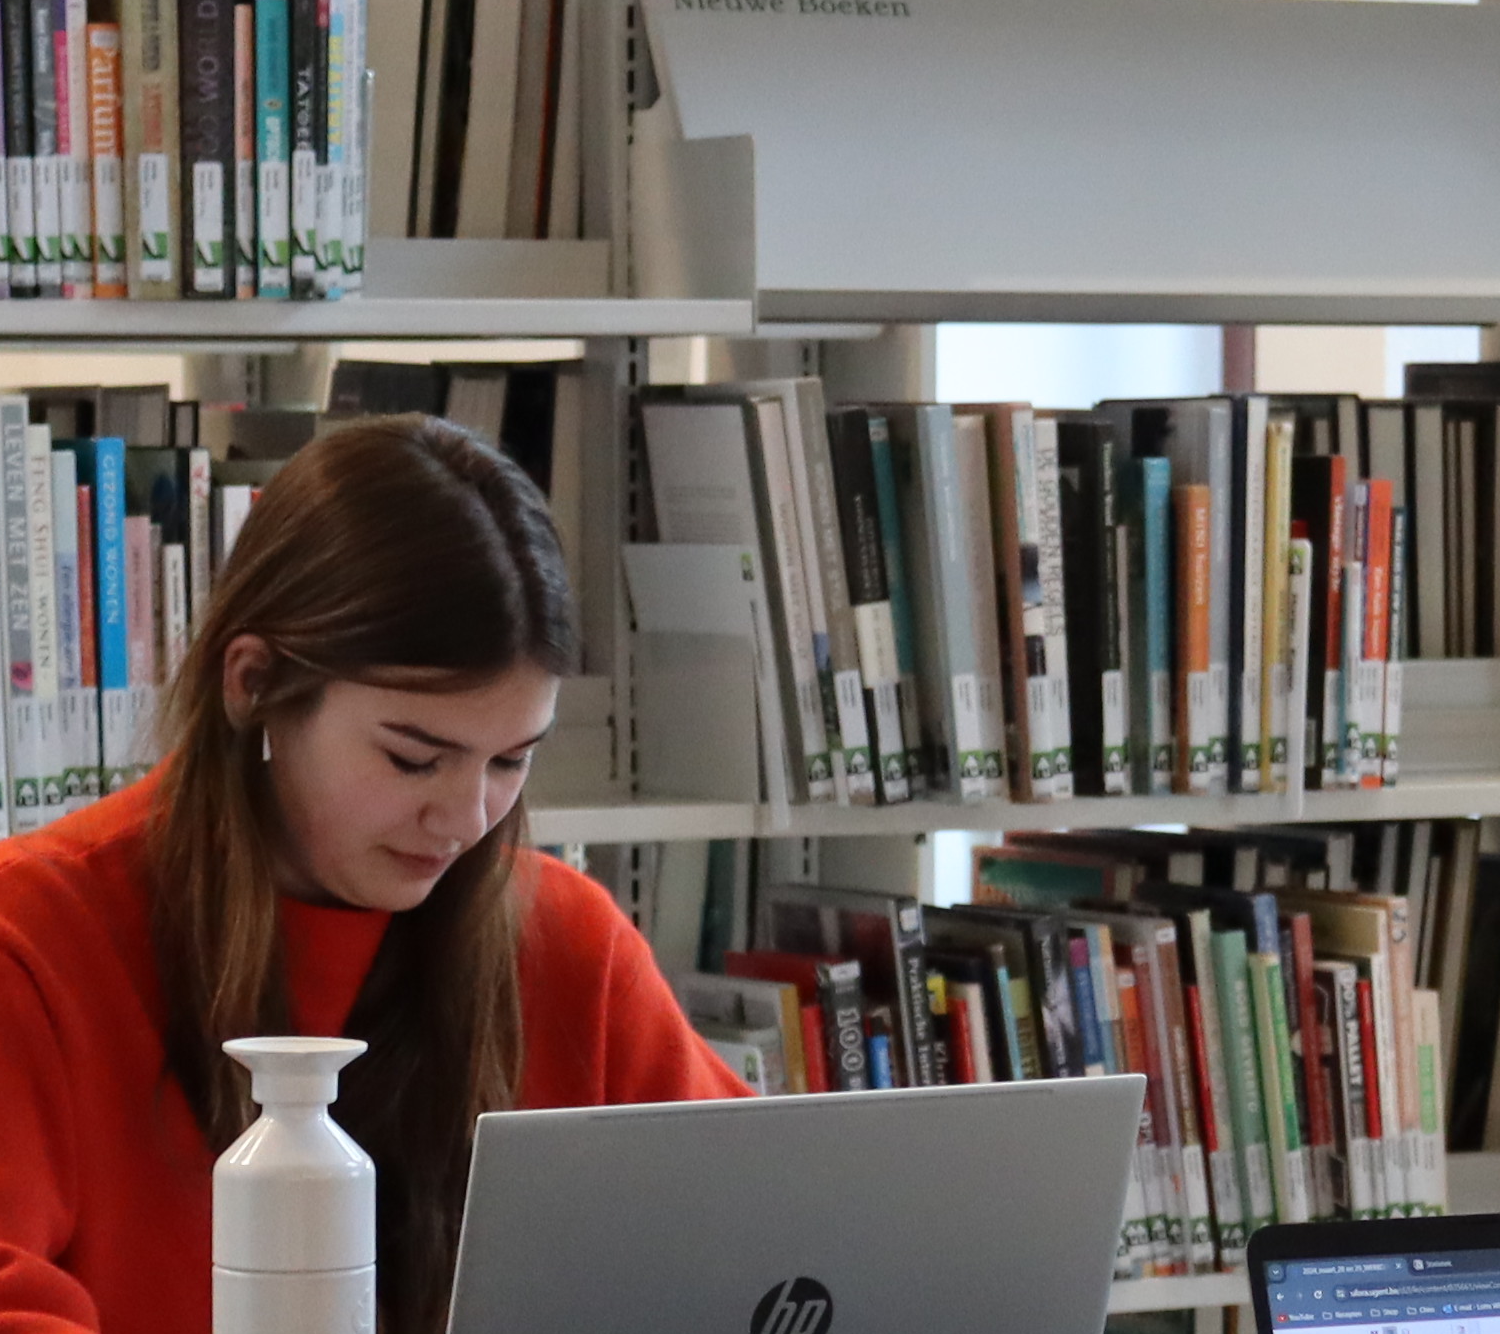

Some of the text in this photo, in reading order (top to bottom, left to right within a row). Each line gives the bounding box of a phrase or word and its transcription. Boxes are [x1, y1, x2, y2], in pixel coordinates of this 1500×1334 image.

[31, 455, 48, 514] FENG
[4, 423, 30, 630] LEVEN MET ZEN
[103, 454, 119, 625] GEZOND WONEN
[37, 596, 52, 669] WONEN
[839, 1006, 865, 1073] 100
